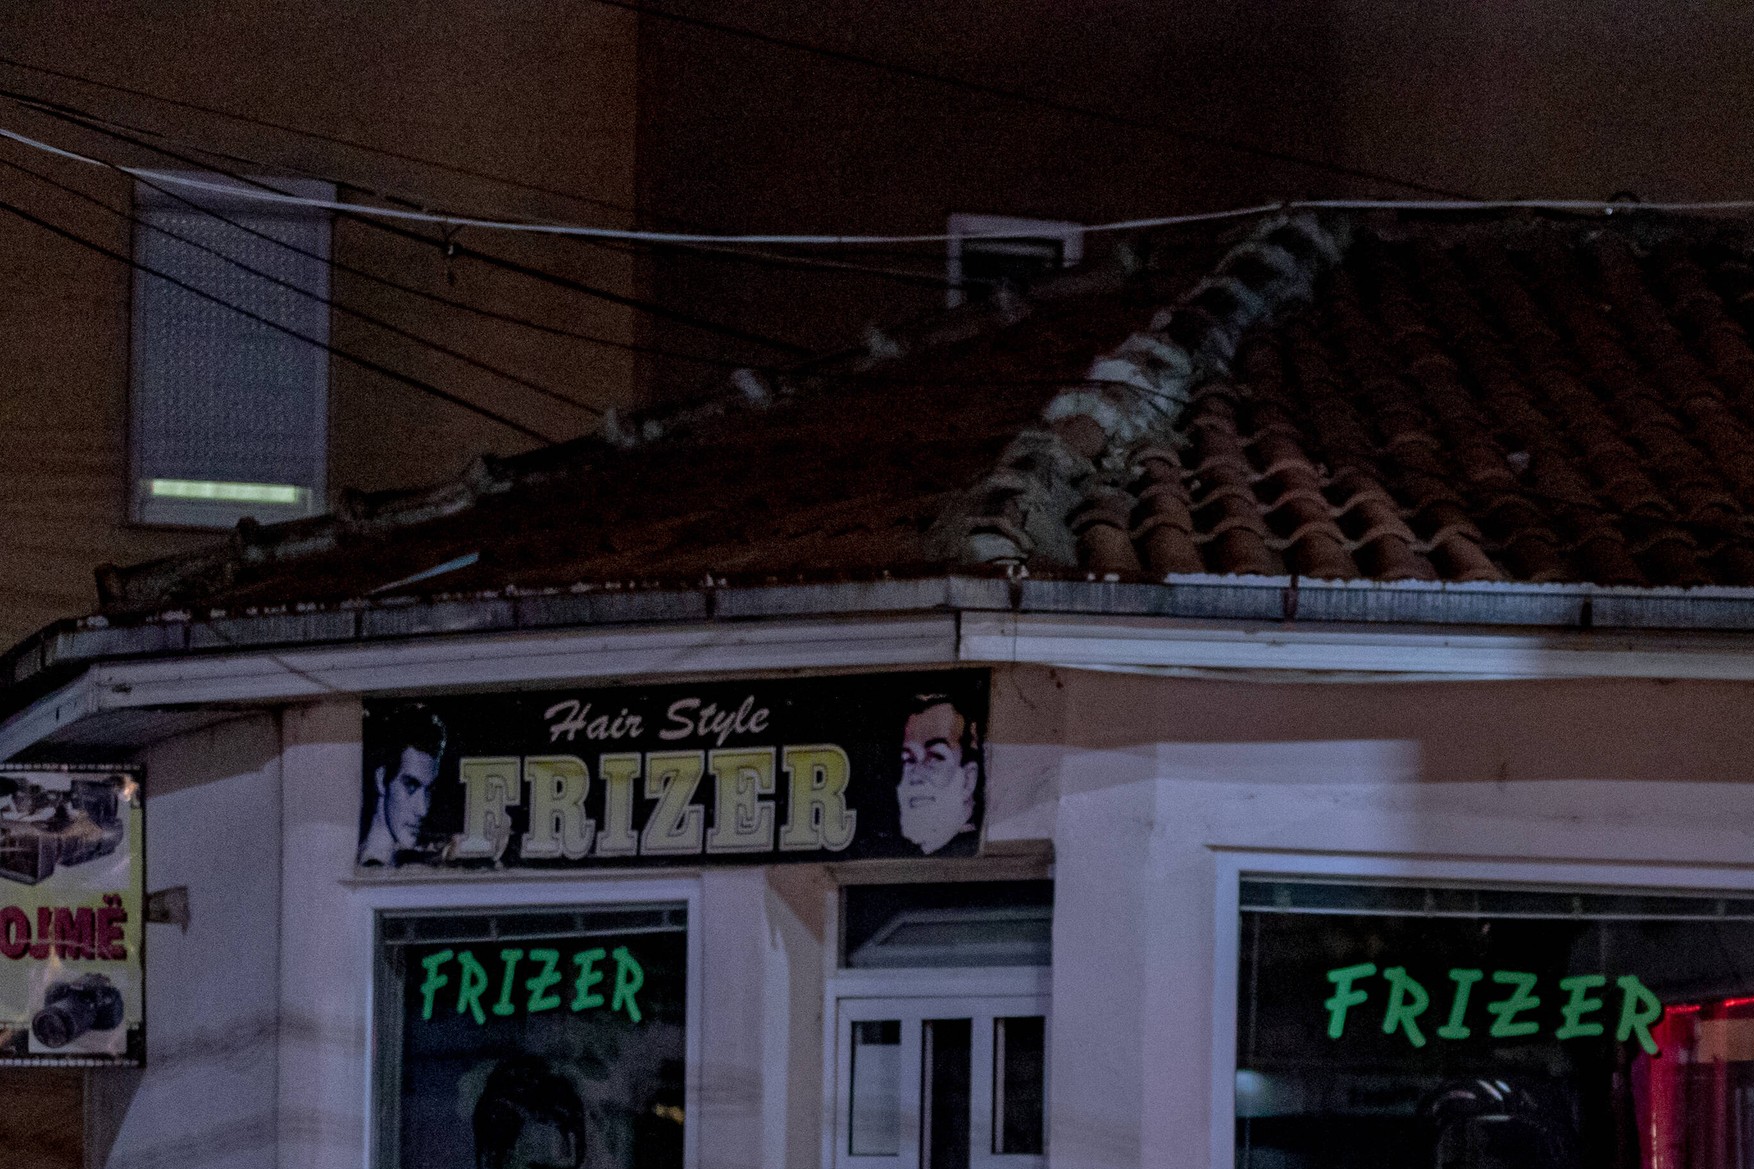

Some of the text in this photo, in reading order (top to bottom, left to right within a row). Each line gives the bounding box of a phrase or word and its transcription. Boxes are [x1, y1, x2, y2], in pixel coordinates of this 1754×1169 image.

[544, 696, 770, 747] Hair Style
[458, 743, 857, 860] FRIZER
[420, 946, 644, 1025] FRIZER
[1325, 963, 1662, 1055] FRIZER
